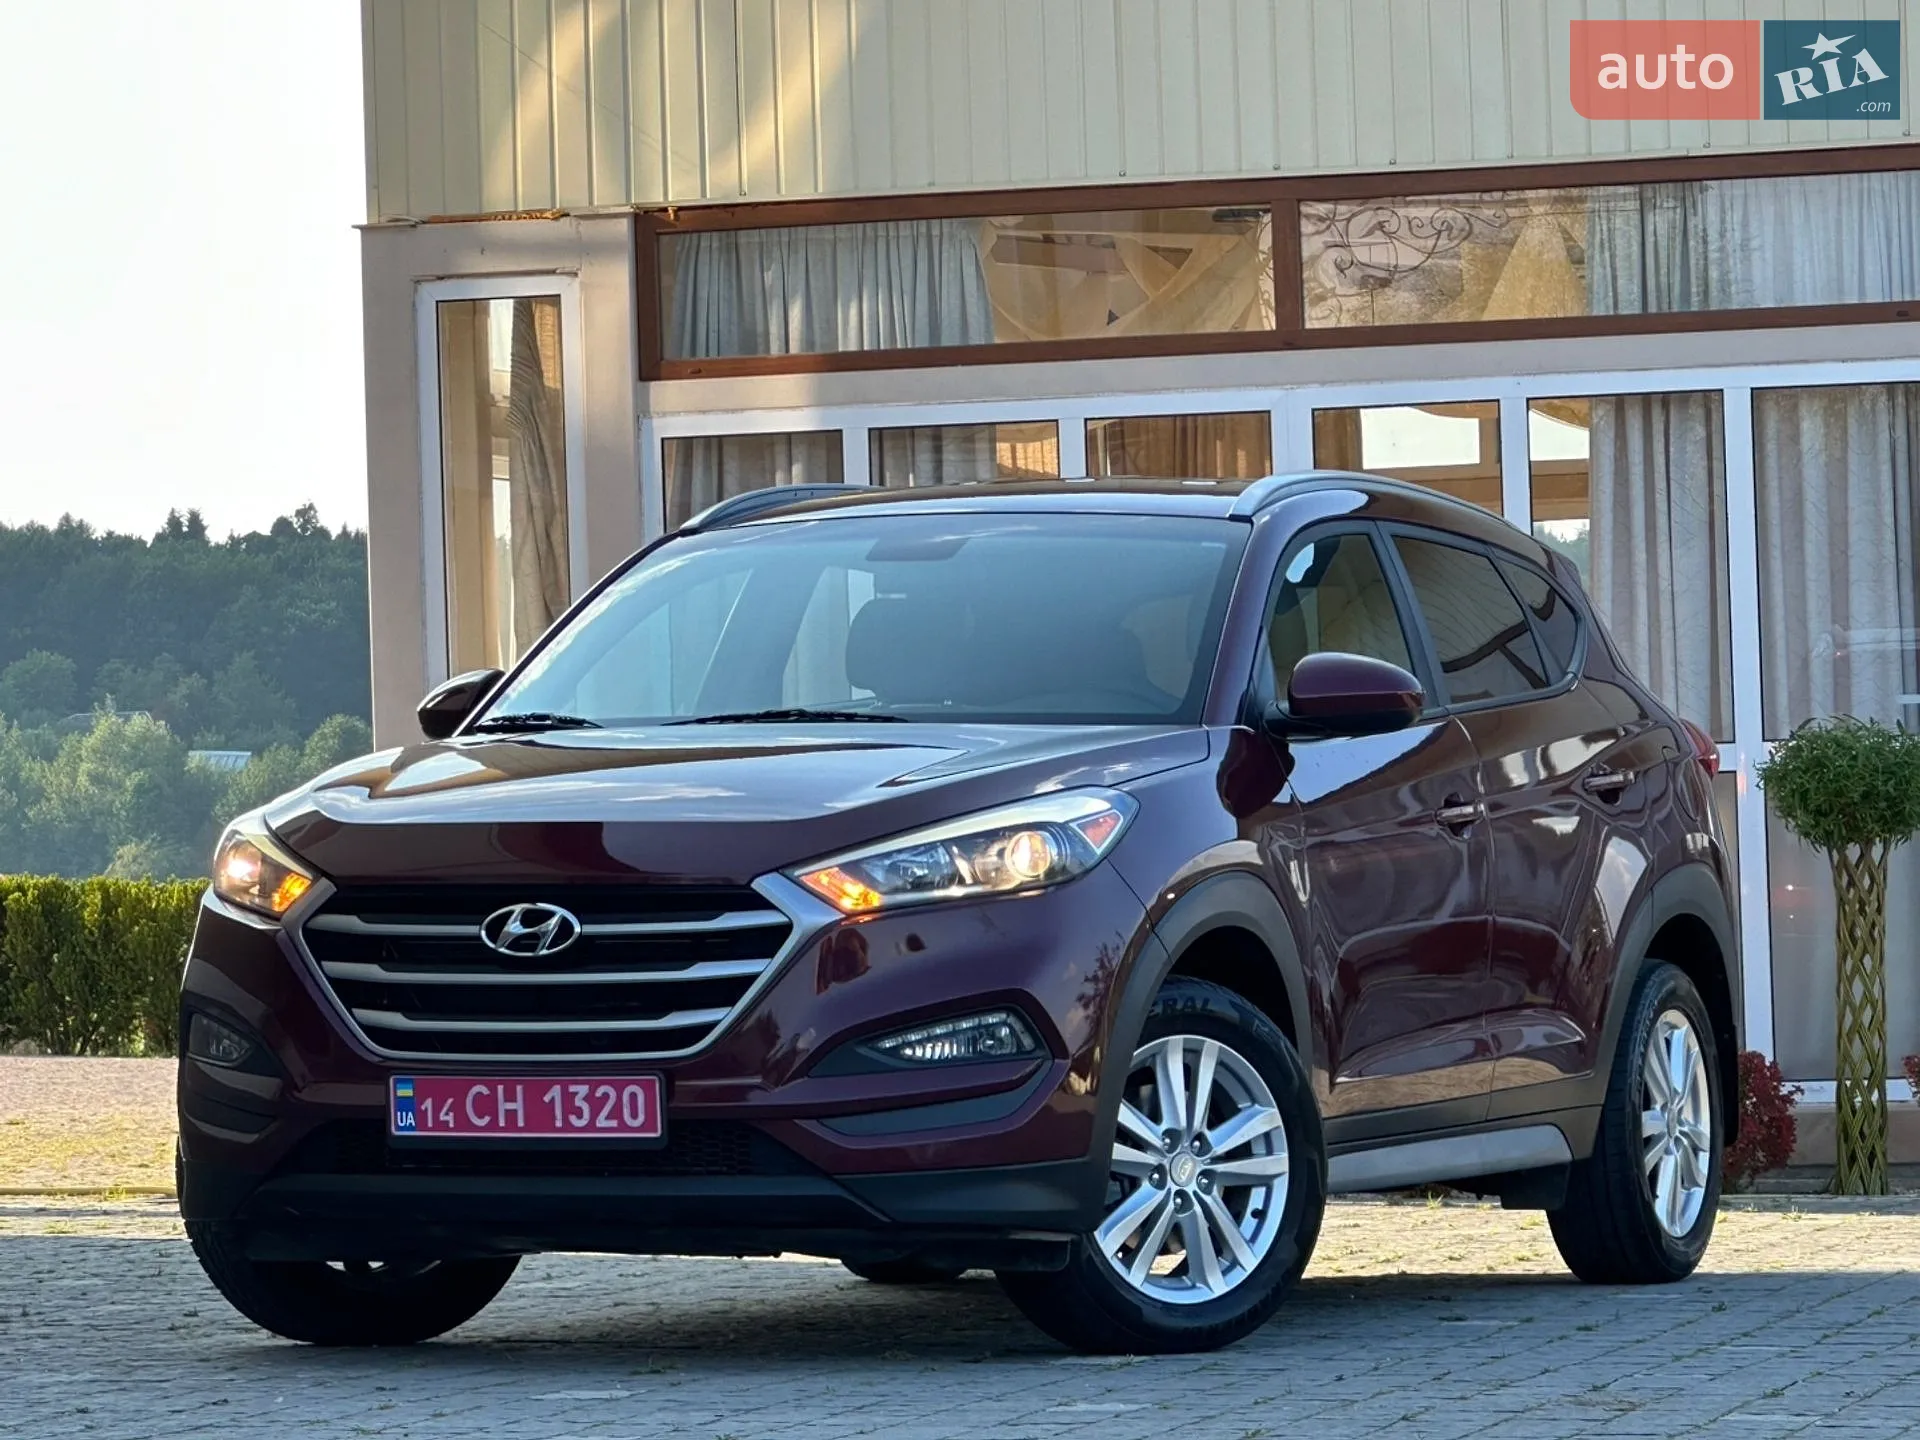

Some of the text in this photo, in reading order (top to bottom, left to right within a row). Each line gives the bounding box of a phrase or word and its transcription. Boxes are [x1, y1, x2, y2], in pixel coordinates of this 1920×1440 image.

[397, 1111, 416, 1127] UA
[421, 1084, 645, 1128] 14 CH 1320
